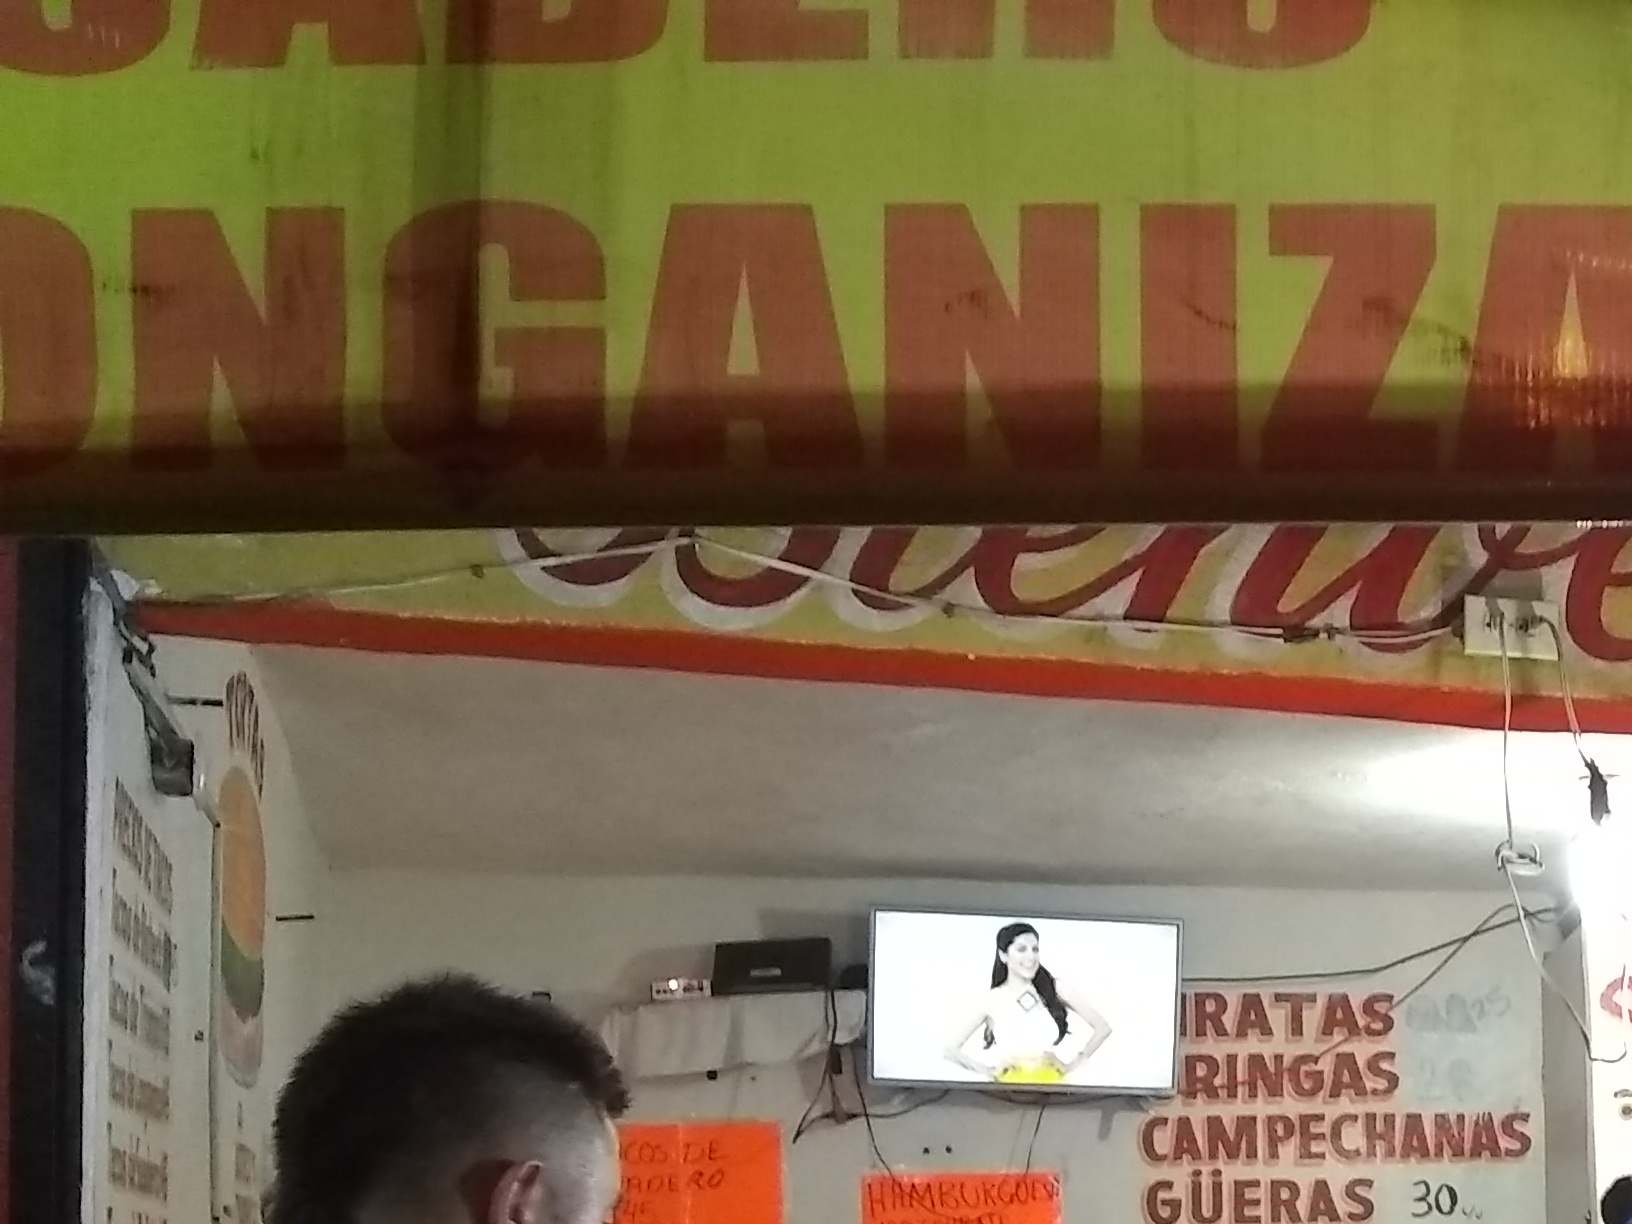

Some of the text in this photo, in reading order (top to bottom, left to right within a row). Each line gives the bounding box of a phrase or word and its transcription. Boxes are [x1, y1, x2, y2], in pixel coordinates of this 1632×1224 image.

[1178, 1051, 1400, 1100] RINGAS
[1141, 1112, 1532, 1161] CAMPECHANAS
[1411, 1179, 1458, 1218] 30
